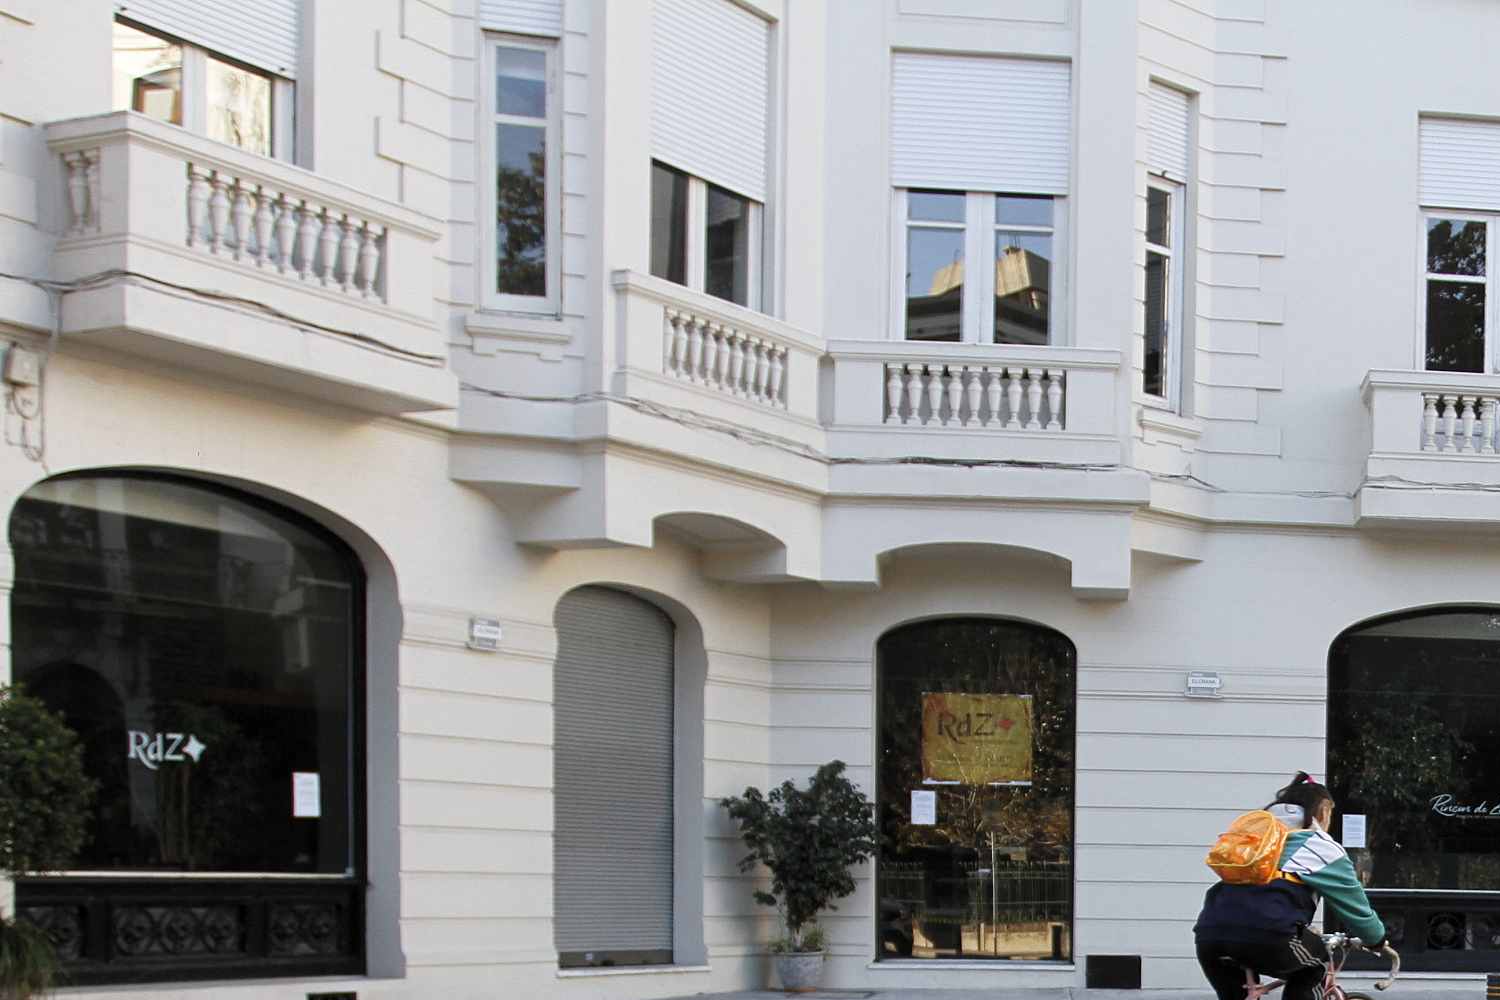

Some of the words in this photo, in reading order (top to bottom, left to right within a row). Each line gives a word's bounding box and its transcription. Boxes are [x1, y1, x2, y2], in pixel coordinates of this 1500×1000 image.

[937, 712, 994, 745] RdZ
[127, 730, 185, 770] RdZ
[1429, 793, 1472, 817] Rincon
[1473, 800, 1488, 813] de
